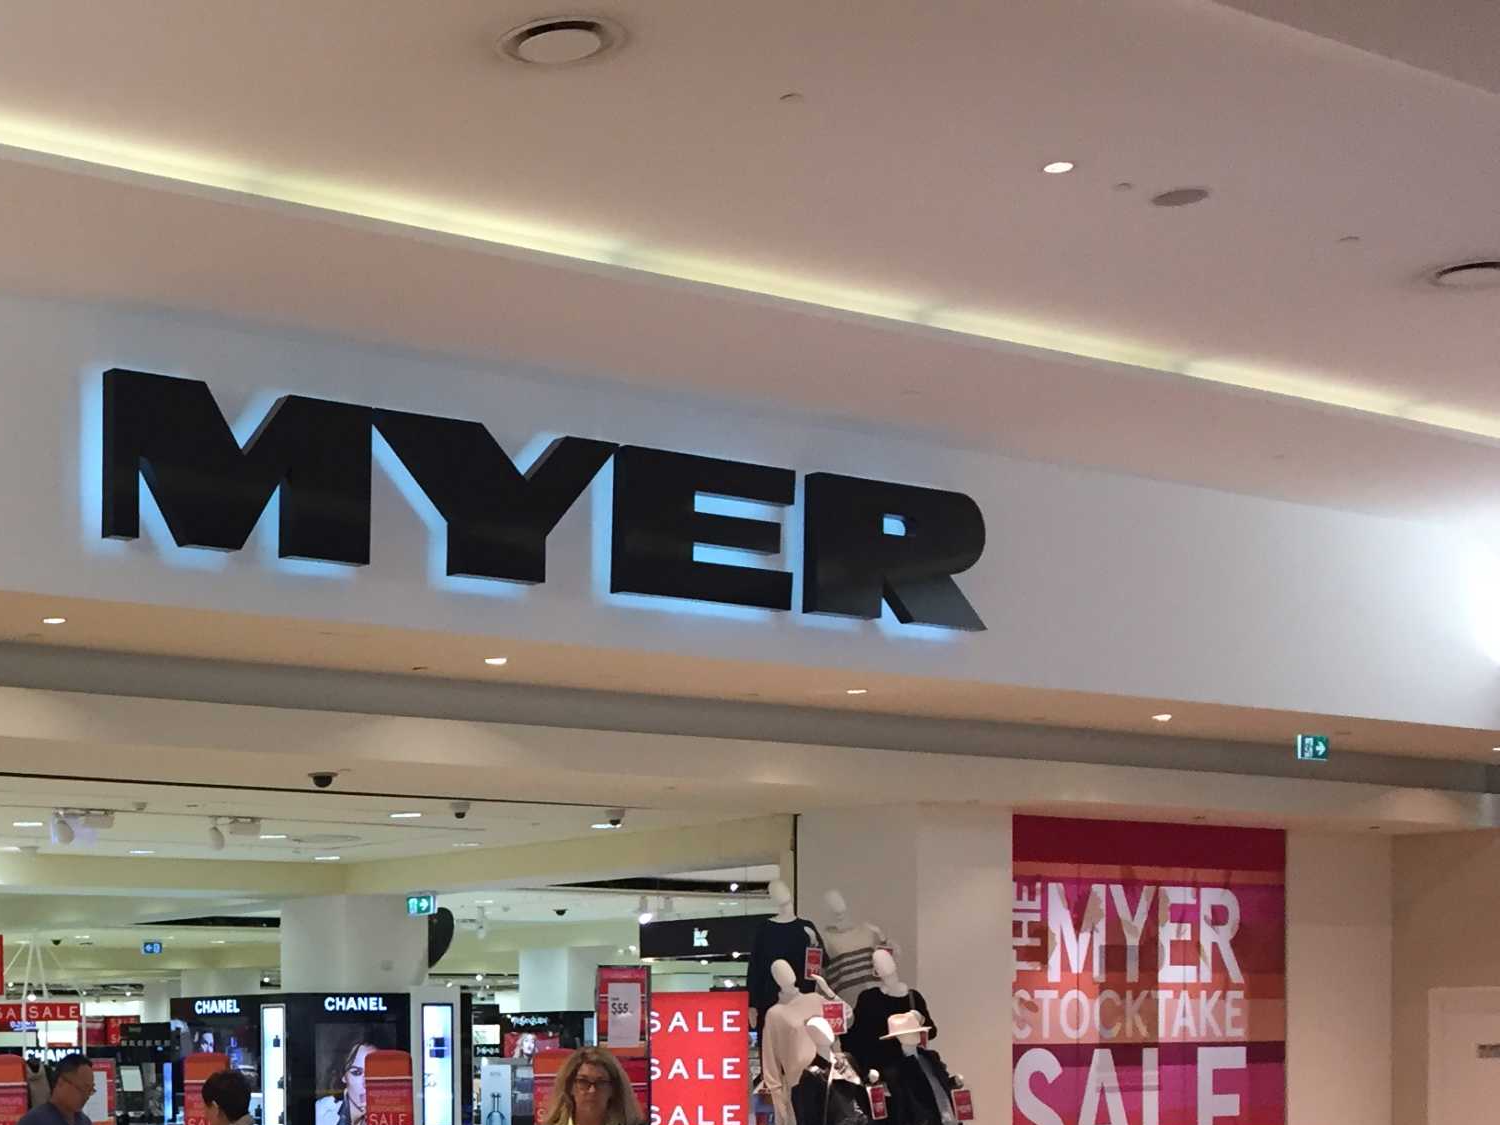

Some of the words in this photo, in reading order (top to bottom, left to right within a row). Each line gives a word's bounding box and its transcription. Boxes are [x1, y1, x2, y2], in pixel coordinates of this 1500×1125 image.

[102, 367, 987, 632] MYER
[1012, 881, 1042, 982] THE
[1047, 882, 1245, 983] MYER
[28, 1005, 79, 1019] SALE
[194, 999, 240, 1015] CHANEL
[324, 996, 388, 1012] CHANEL
[1012, 989, 1248, 1040] STOCKTAKE
[650, 1011, 741, 1033] SALE
[650, 1057, 741, 1080] SALE
